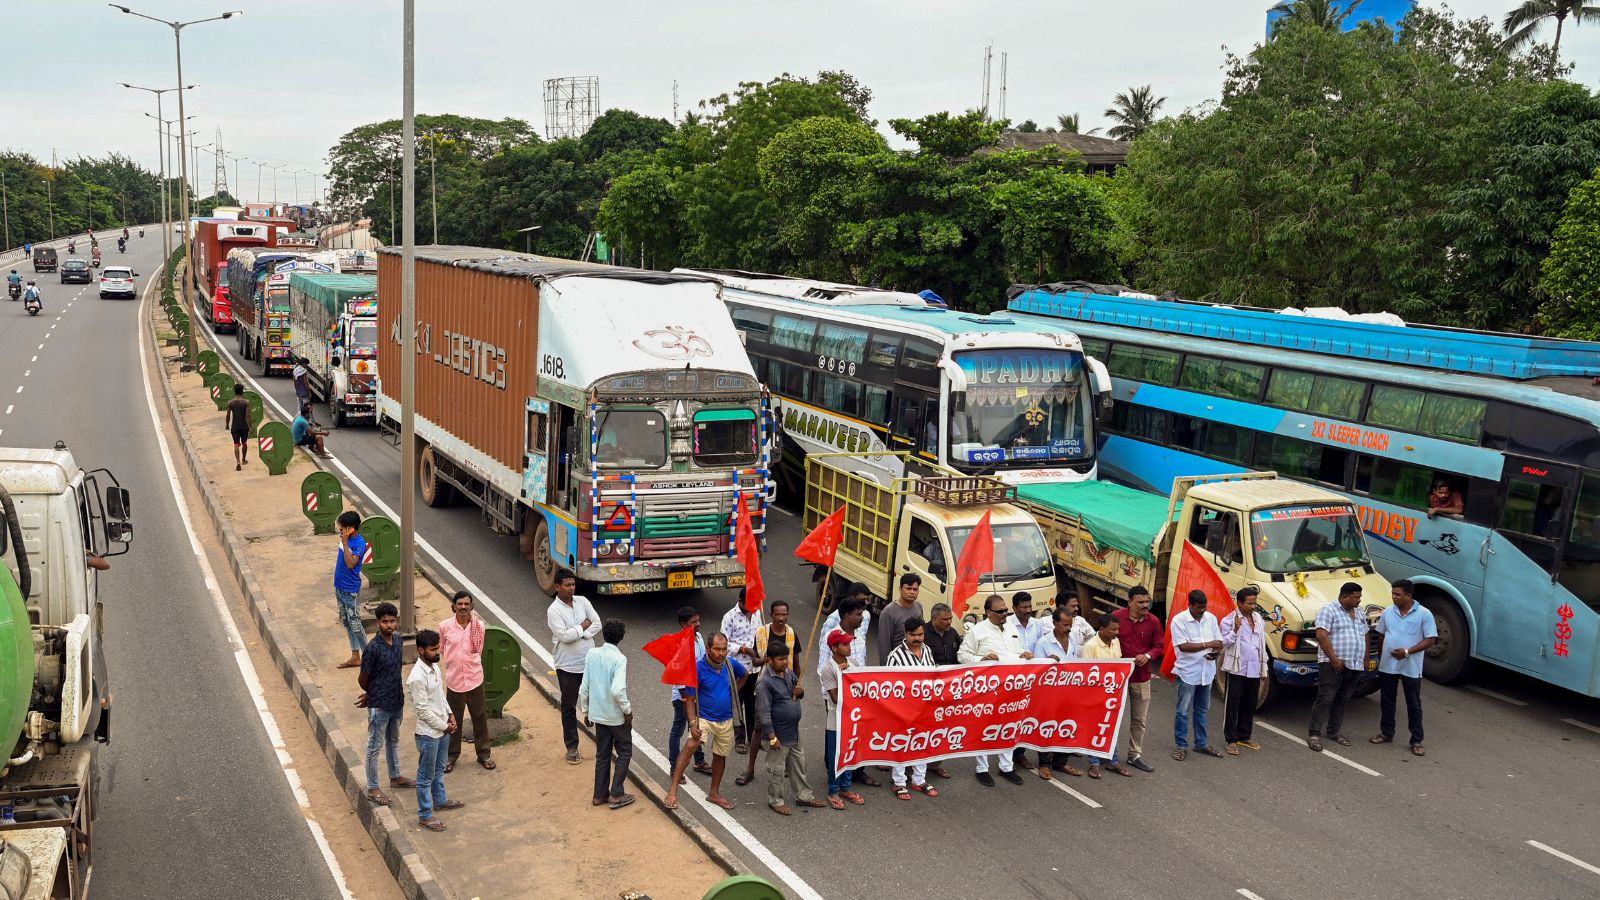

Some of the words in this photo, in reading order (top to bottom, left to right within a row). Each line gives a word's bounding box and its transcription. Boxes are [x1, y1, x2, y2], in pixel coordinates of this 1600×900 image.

[980, 355, 1074, 383] PADHI
[784, 407, 870, 459] MAHAVEER
[1311, 420, 1326, 438] 2X2
[1327, 423, 1361, 446] SLEEPER
[1362, 430, 1390, 452] COACH
[1358, 504, 1419, 544] UDEV
[632, 583, 660, 592] GOOD
[694, 578, 723, 588] LUCK
[850, 680, 906, 699] ଭାରତର
[843, 707, 861, 763] CITU
[1091, 697, 1118, 748] CITU
[869, 727, 966, 752] ଧର୍ମଘଟକୁ
